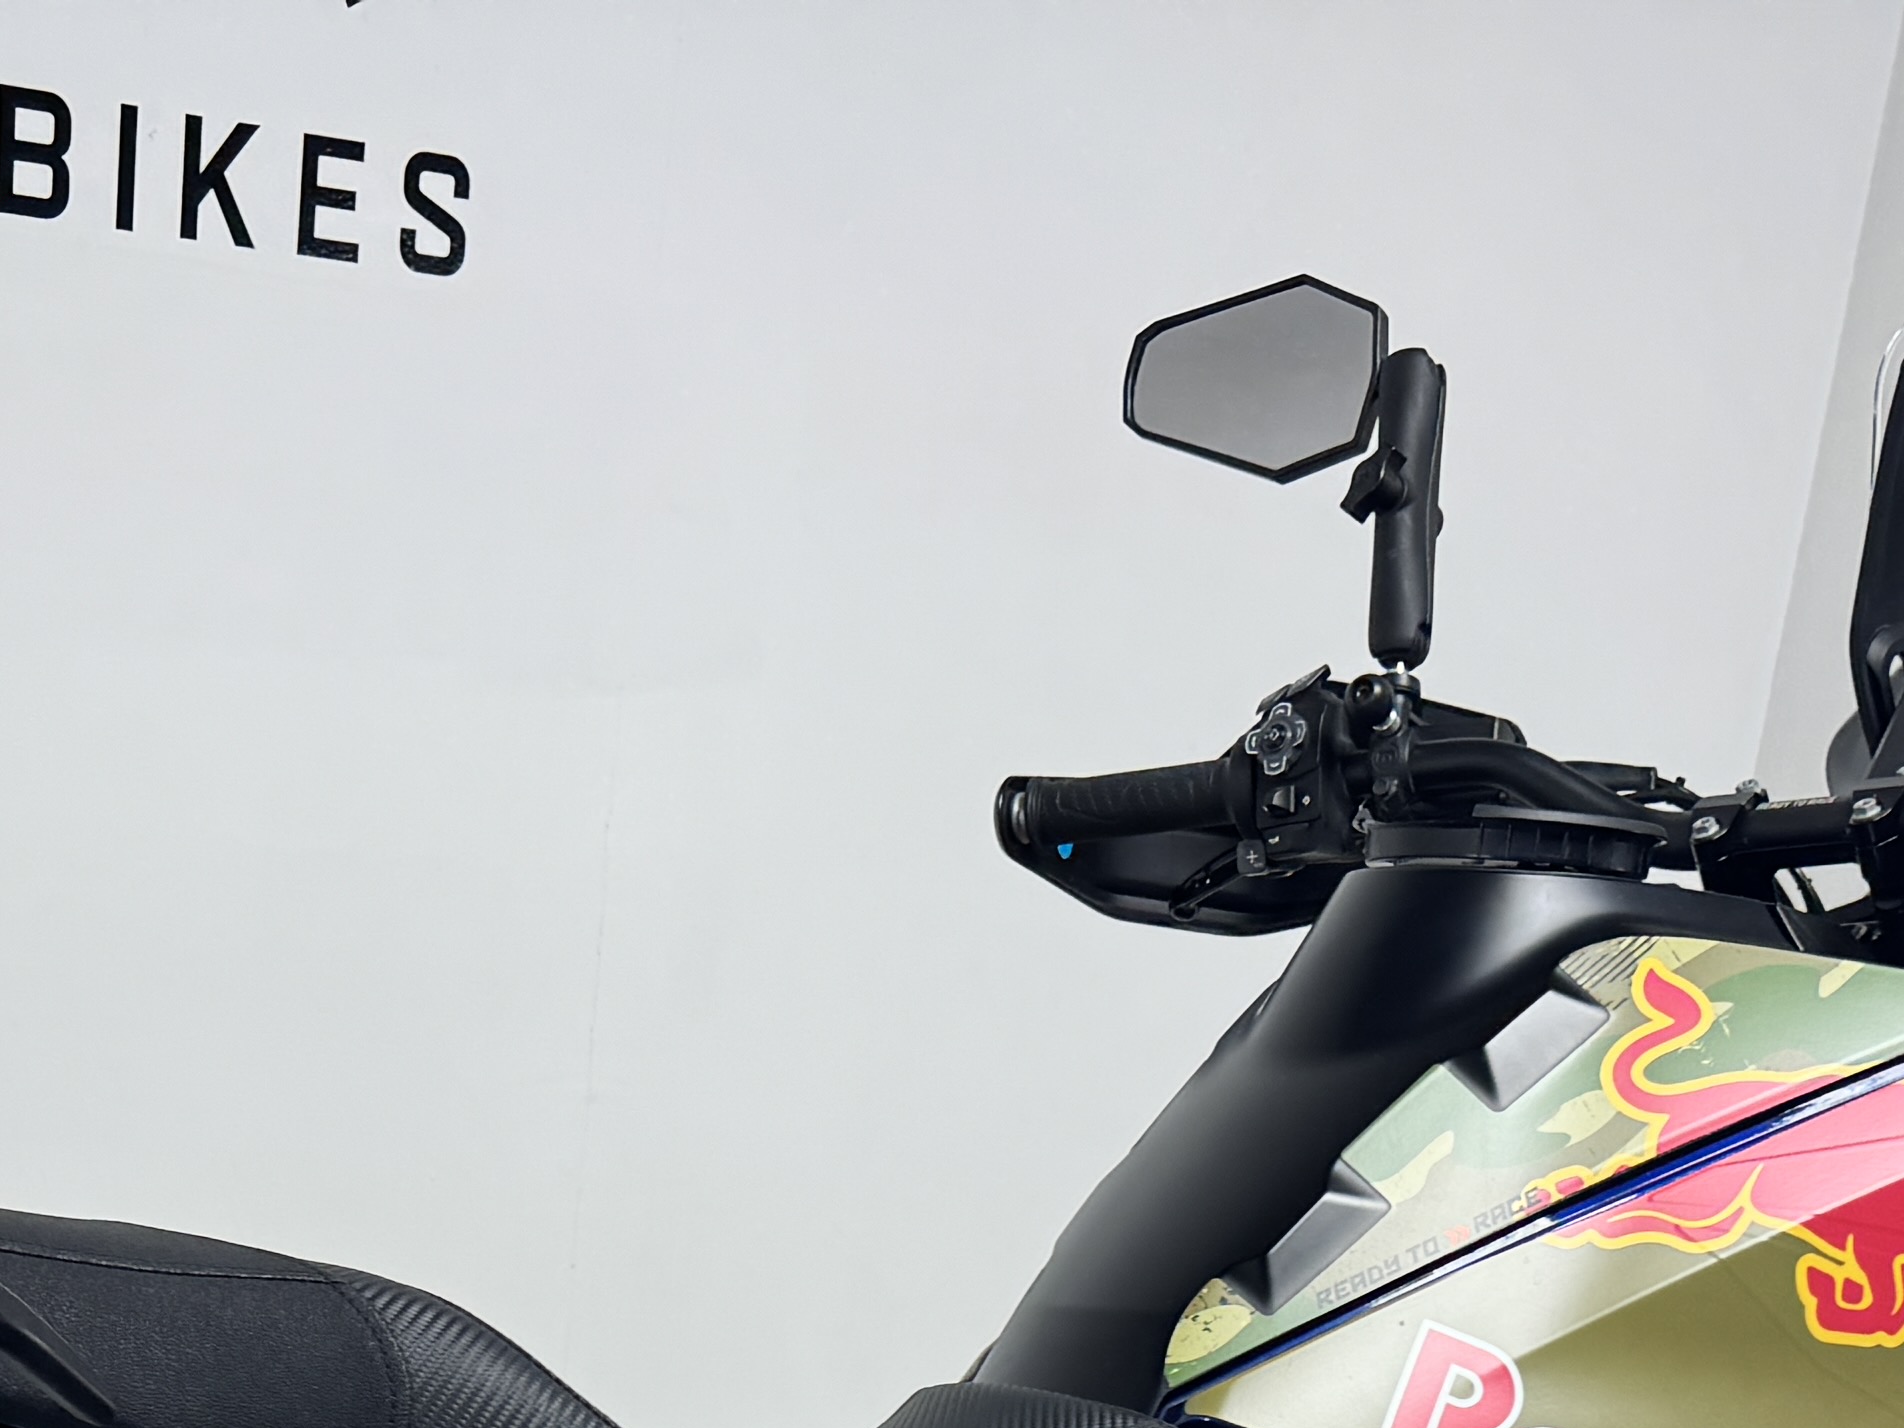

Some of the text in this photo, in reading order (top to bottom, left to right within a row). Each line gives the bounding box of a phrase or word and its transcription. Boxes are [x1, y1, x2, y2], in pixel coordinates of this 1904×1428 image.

[1314, 1186, 1543, 1310] READY TO RACE
